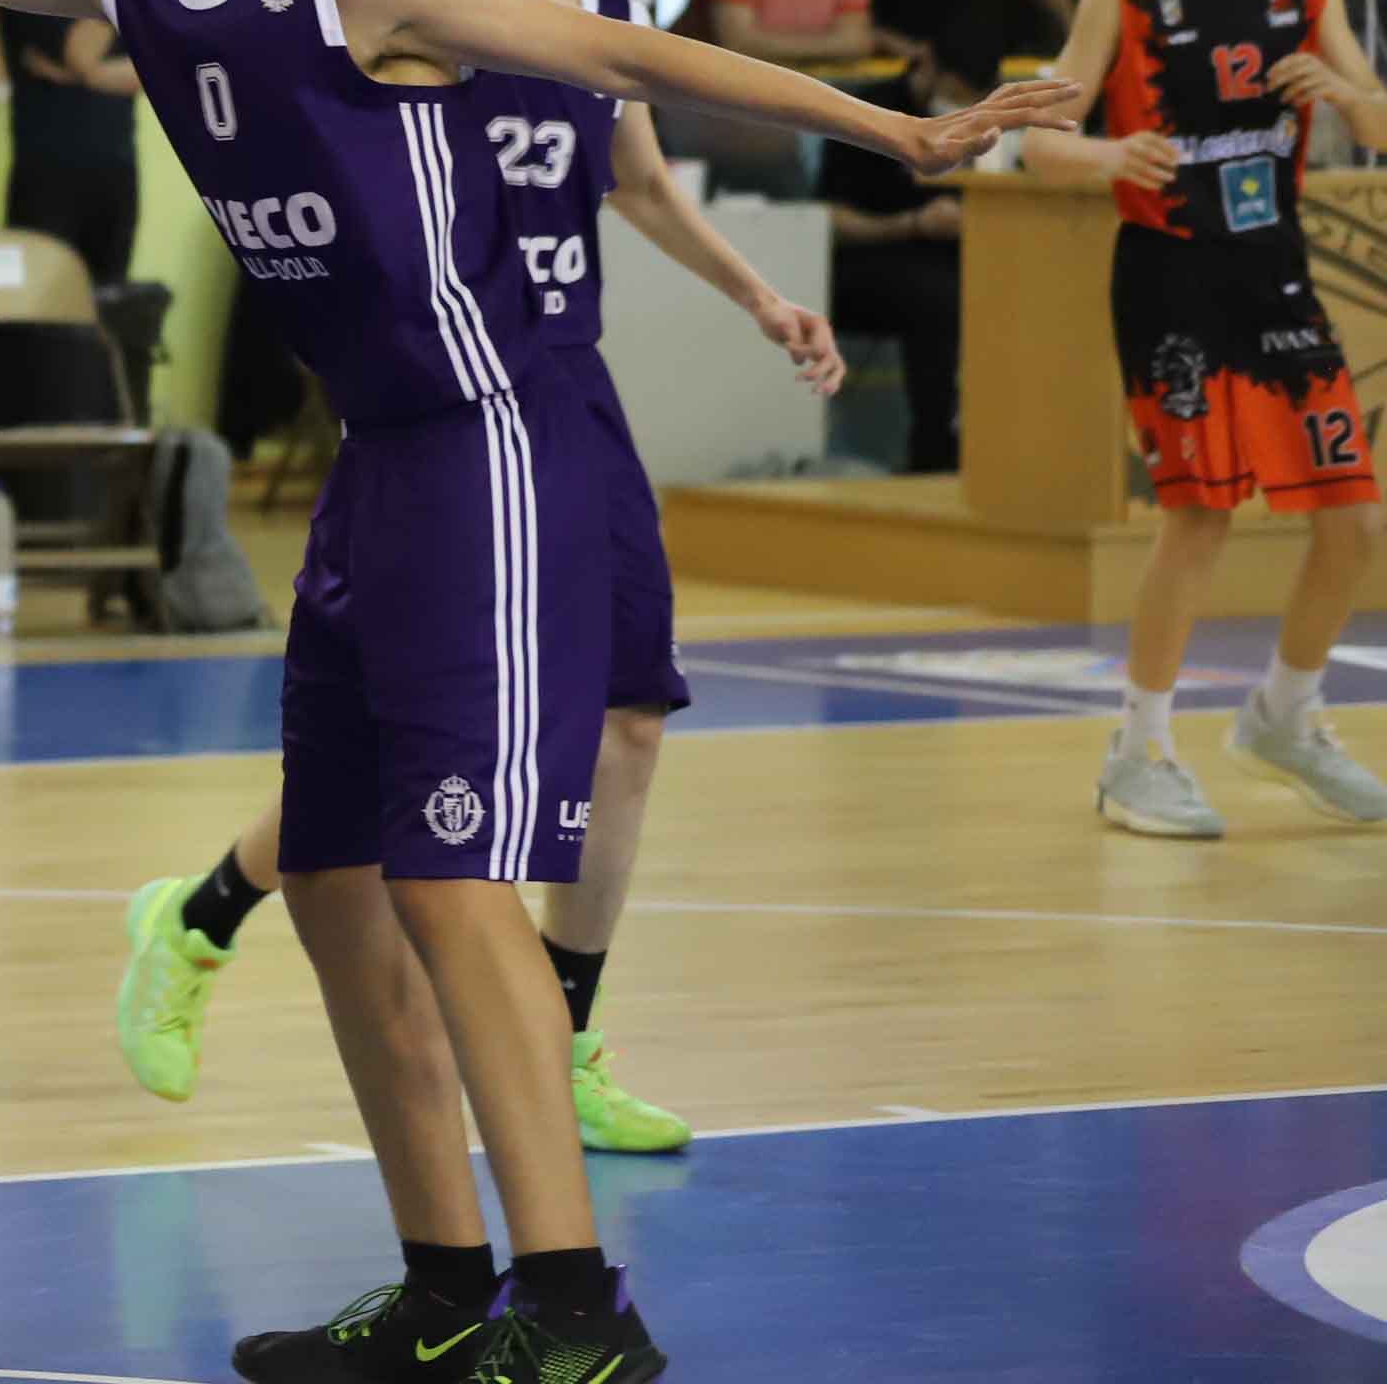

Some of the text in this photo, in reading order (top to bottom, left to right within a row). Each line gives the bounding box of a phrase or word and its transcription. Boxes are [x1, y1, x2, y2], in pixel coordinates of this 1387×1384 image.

[1211, 41, 1263, 102] 12
[483, 116, 578, 189] 23
[1304, 410, 1360, 470] 12
